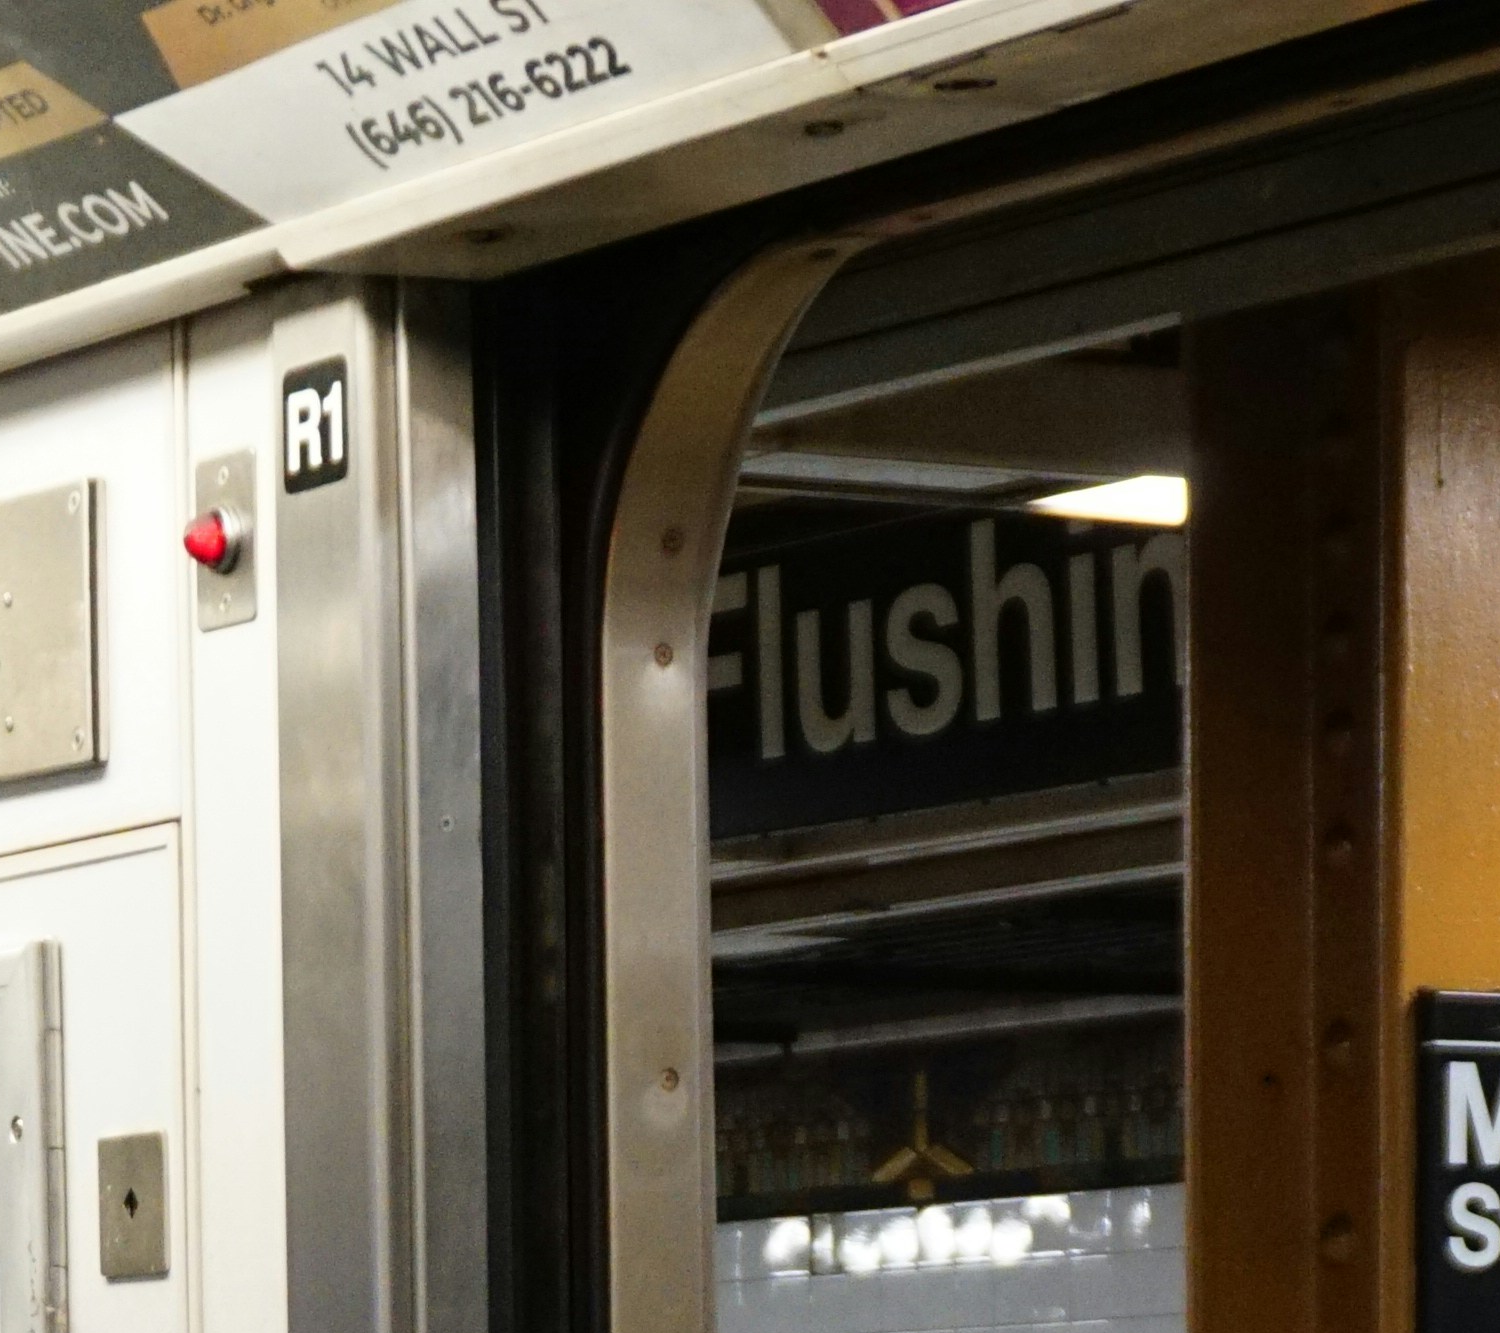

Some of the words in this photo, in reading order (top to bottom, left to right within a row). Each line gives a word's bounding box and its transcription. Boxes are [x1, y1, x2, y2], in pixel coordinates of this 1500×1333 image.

[316, 52, 377, 96] 14
[365, 8, 500, 77] WALL
[345, 95, 465, 171] (646)
[449, 36, 633, 126] 216-6222
[285, 378, 346, 476] R1
